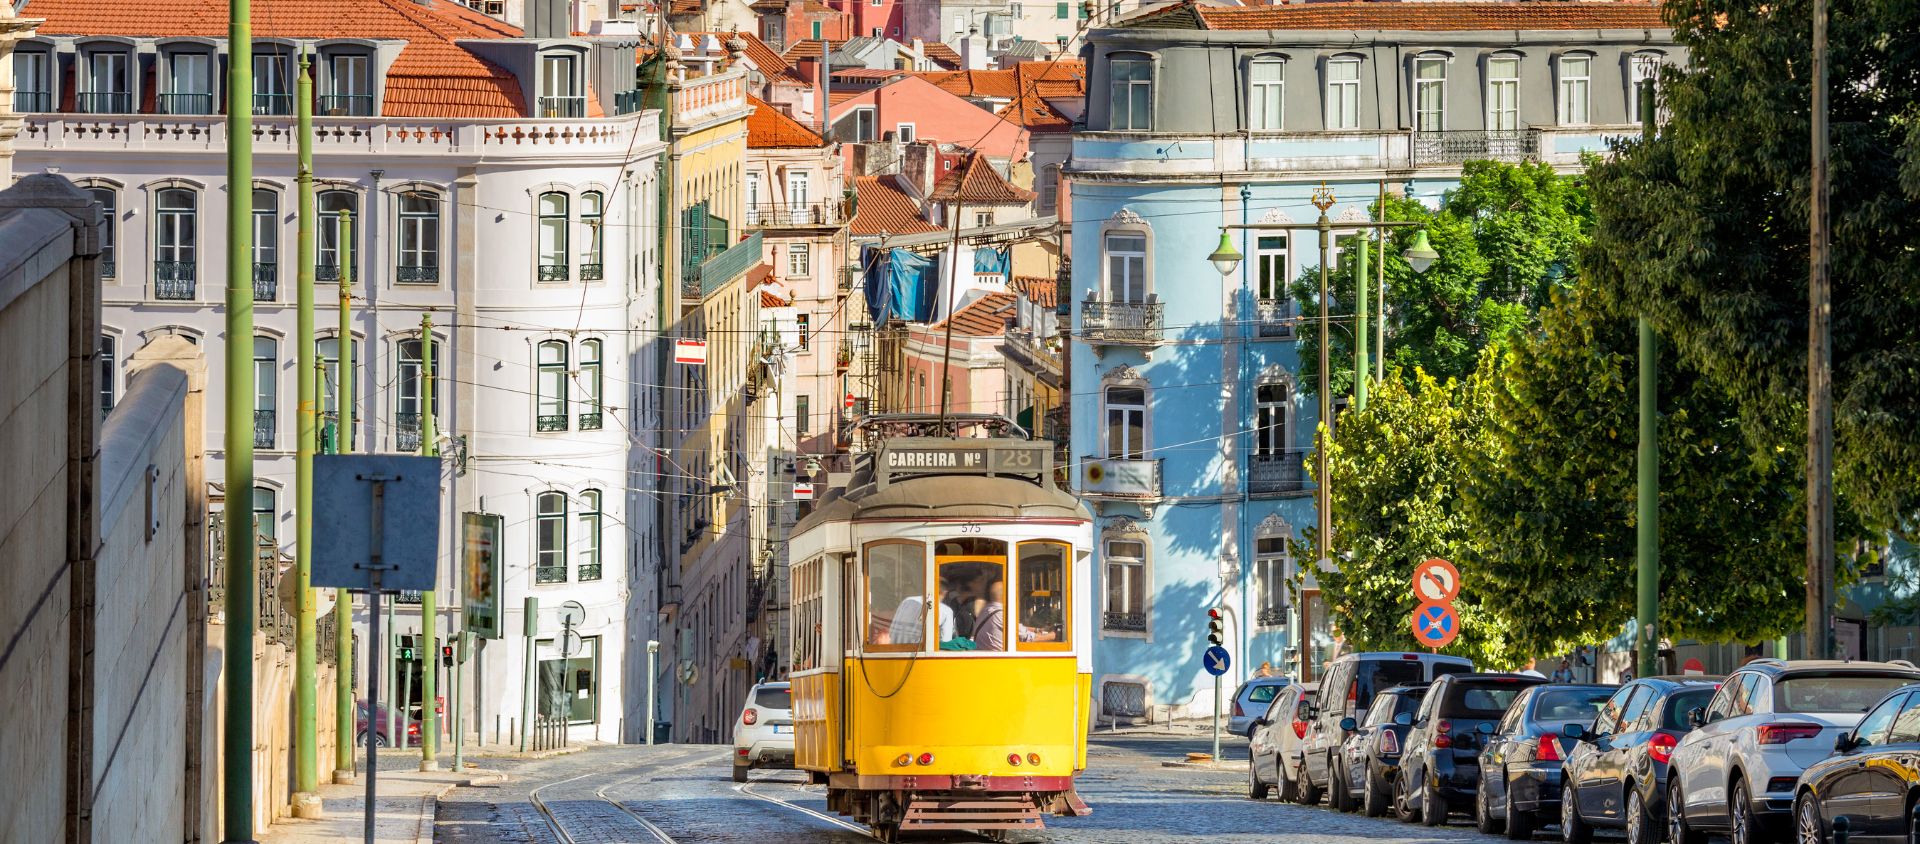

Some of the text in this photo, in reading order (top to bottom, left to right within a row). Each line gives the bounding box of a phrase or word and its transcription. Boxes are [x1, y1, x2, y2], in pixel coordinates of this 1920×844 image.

[888, 450, 1032, 467] CARREIRA Nº 28
[961, 523, 981, 533] 575
